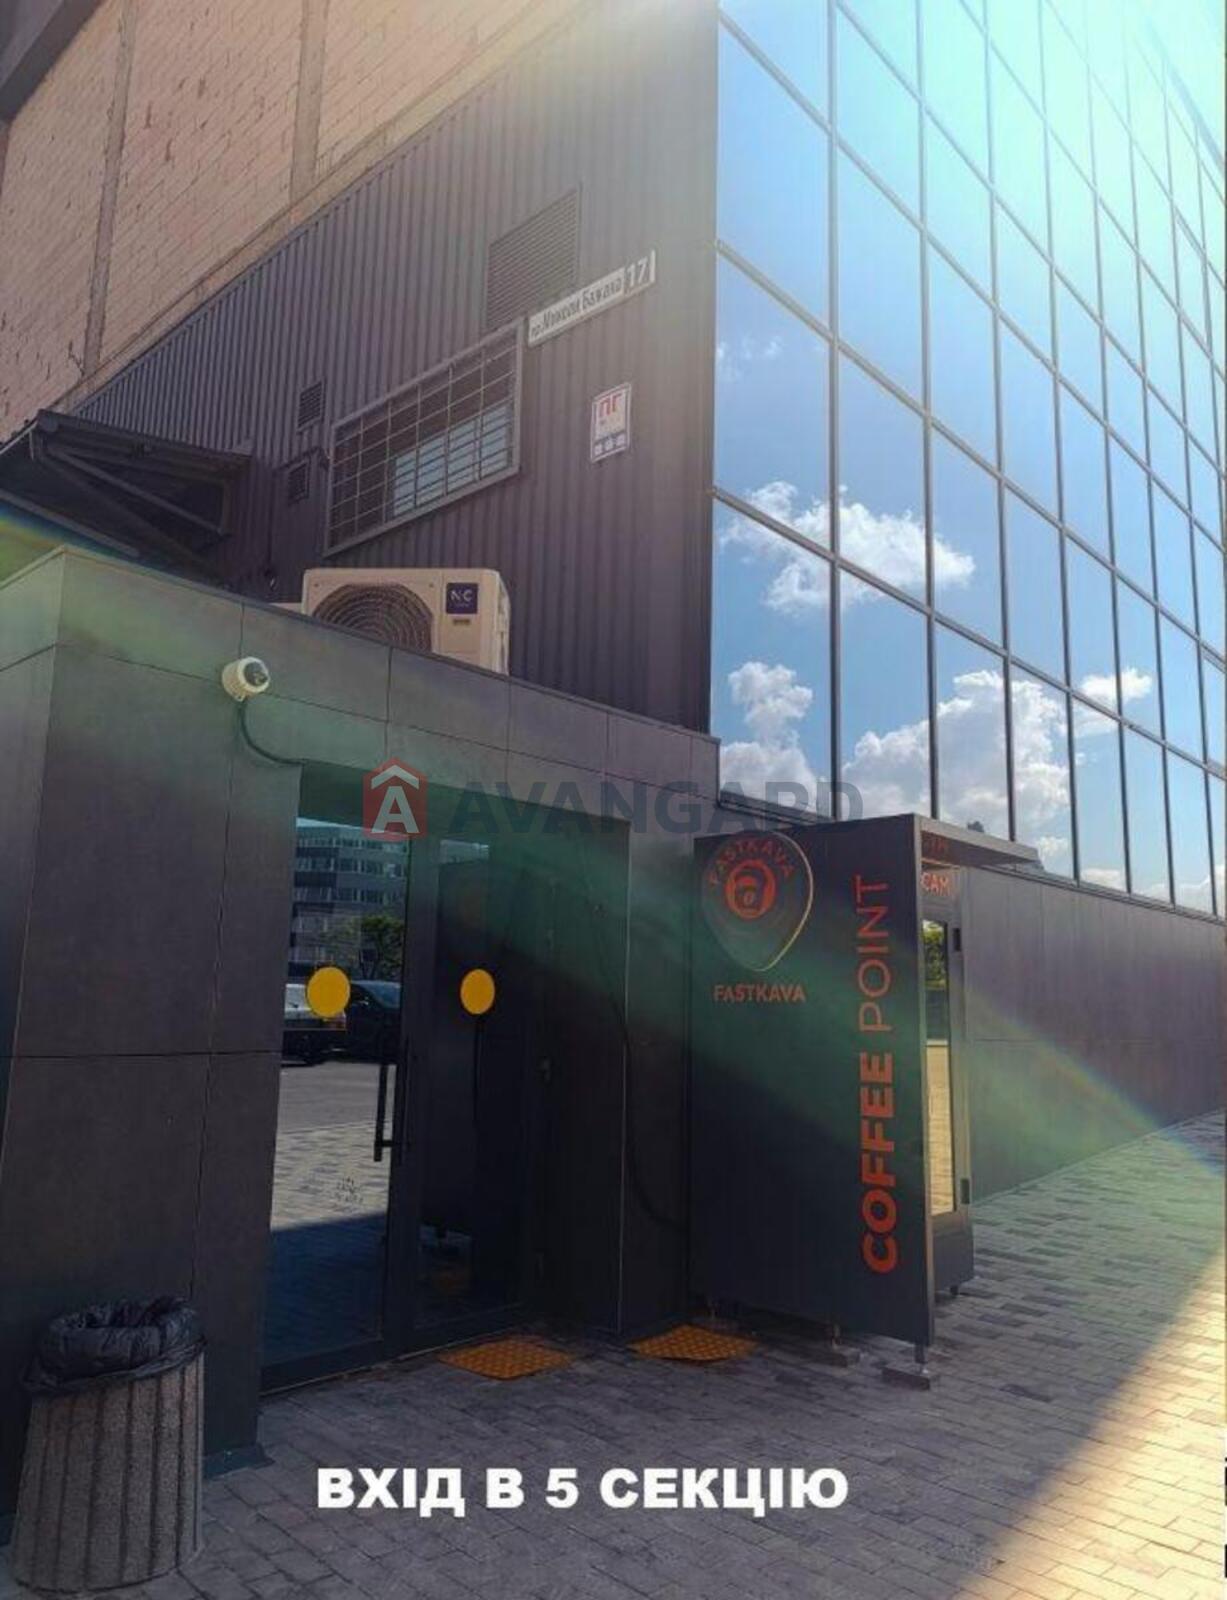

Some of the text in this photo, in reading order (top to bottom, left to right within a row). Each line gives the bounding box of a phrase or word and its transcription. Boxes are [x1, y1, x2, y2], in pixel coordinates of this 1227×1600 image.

[627, 255, 648, 288] 17
[713, 983, 806, 1003] FASTKAVA
[855, 875, 898, 1274] COFFEE POINT
